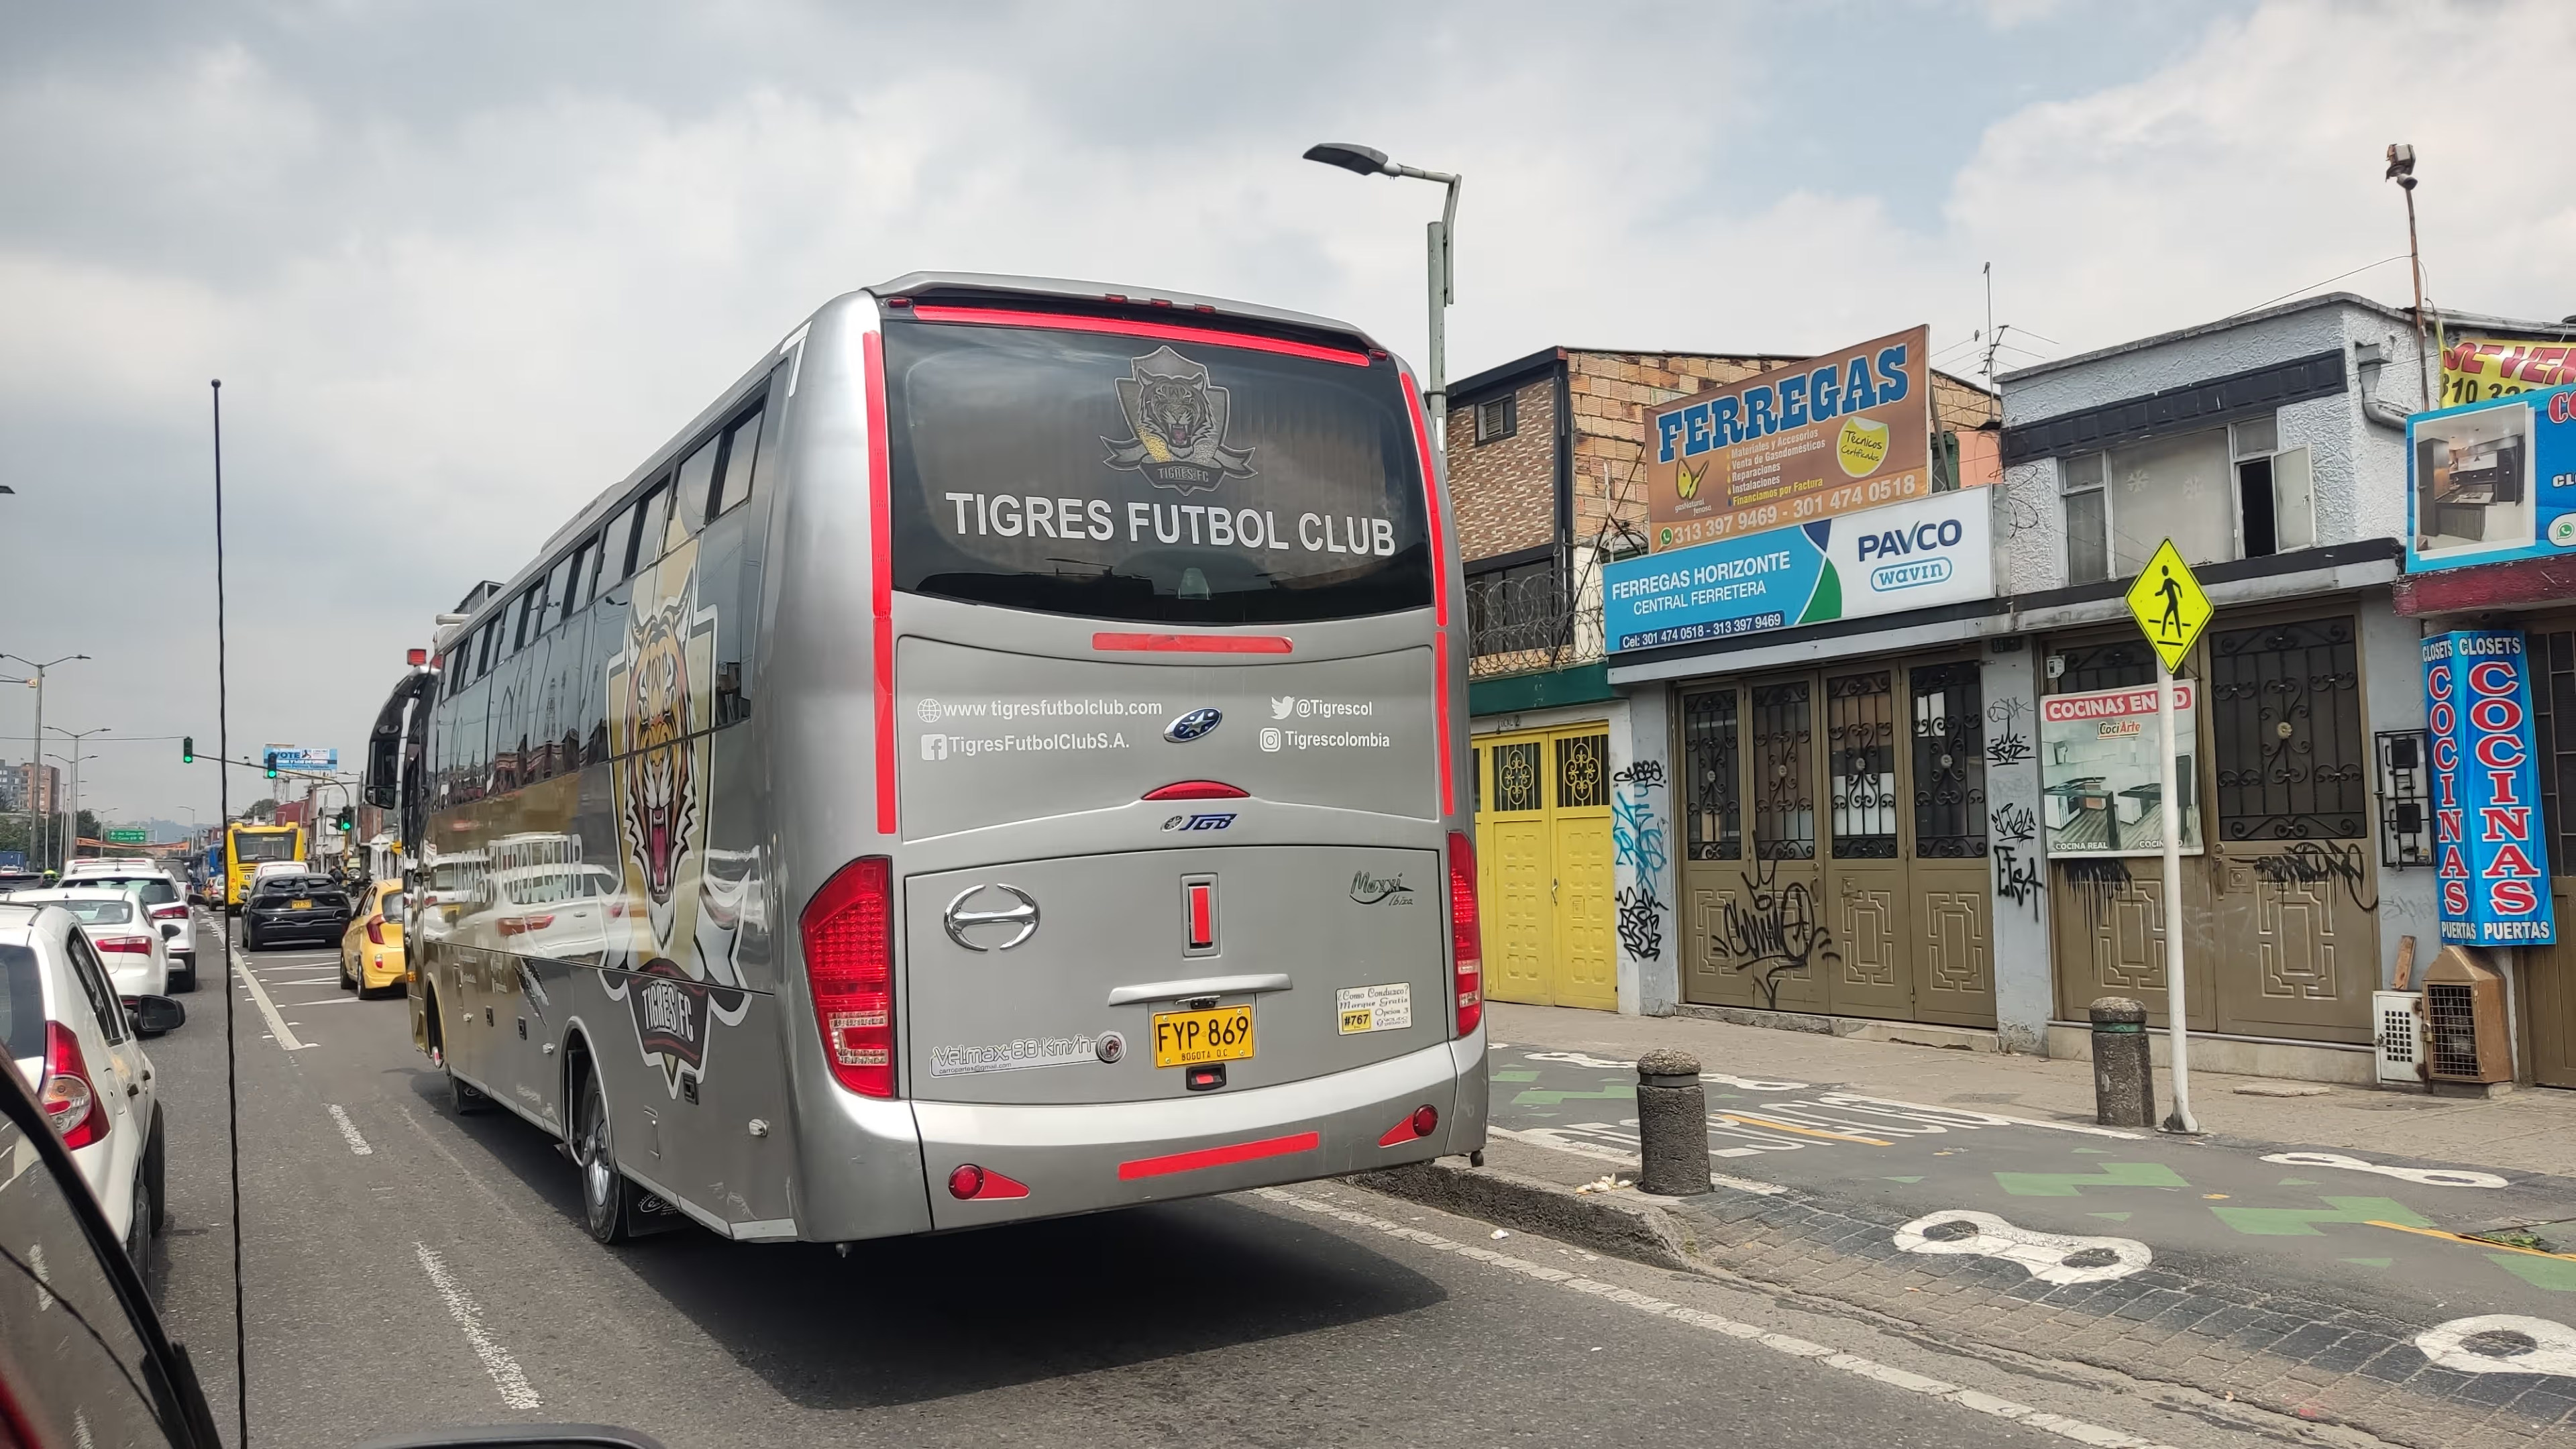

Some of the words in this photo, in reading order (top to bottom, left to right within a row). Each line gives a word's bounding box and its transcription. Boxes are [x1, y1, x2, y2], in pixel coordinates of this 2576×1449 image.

[1656, 343, 1909, 464] FERREGAS
[1731, 441, 1769, 459] Materiales
[1771, 441, 1776, 449] y
[1778, 429, 1818, 447] Accesorios
[1845, 430, 1882, 449] Técnicos
[1731, 458, 1752, 470] Venta
[1754, 453, 1763, 464] de
[1765, 439, 1825, 461] Gasodomésticos
[1157, 466, 1193, 480] TIGRES
[1195, 470, 1209, 482] FC
[1732, 462, 1781, 482] Reparaciones
[1732, 475, 1780, 494] Instalaciones
[1733, 489, 1777, 506] Financiamos
[1779, 484, 1792, 497] por
[1794, 477, 1823, 492] Factura
[1674, 523, 1701, 544] 313
[1705, 517, 1733, 535] 397
[1738, 507, 1777, 530] 9469
[1793, 498, 1822, 519] 301
[1829, 488, 1863, 511] 474
[1868, 474, 1915, 502] 0518
[946, 492, 1114, 541] TIGRES
[1127, 502, 1289, 549] FUTBOL
[1299, 513, 1395, 555] CLUB
[1858, 519, 1962, 562] PAVCO
[1612, 570, 1690, 600] FERREGAS
[1694, 551, 1790, 585] HORIZONTE
[1878, 561, 1942, 588] wavin
[1633, 594, 1688, 615] CENTRAL
[1691, 580, 1766, 606] FERRETERA
[1622, 635, 1640, 649] Cel:
[1642, 631, 1658, 645] 301
[1661, 629, 1678, 643] 474
[1680, 625, 1704, 639] 0518
[1713, 621, 1731, 635] 313
[1734, 618, 1752, 632] 397
[1755, 613, 1781, 629] 9469
[2422, 640, 2453, 663] CLOSETS
[2459, 636, 2521, 656] CLOSETS
[991, 699, 1162, 720] tigresfutbolclub.com
[1297, 699, 1373, 718] @Tigrescol
[2049, 696, 2126, 718] COCINAS
[2129, 694, 2156, 712] EN
[2100, 720, 2141, 735] CociArte
[949, 733, 1129, 756] TigresFutbolClubS.A.
[1285, 731, 1390, 749] Tigrescolombia
[2428, 665, 2469, 916] COCINAS
[2469, 661, 2542, 916] COCINAS
[2055, 842, 2086, 850] COCINA
[2088, 841, 2108, 849] REAL
[2139, 840, 2164, 849] COCIN
[2441, 920, 2476, 940] PUERTAS
[2483, 920, 2550, 941] PUERTAS
[642, 980, 678, 1032] TIGRES
[677, 991, 694, 1043] FC
[1379, 997, 1407, 1007] Gratis
[1344, 1014, 1369, 1026] #767
[1157, 1020, 1199, 1053] FYP
[1208, 1016, 1248, 1046] 869
[1011, 1038, 1039, 1059] 80
[1042, 1034, 1091, 1057] Km/h
